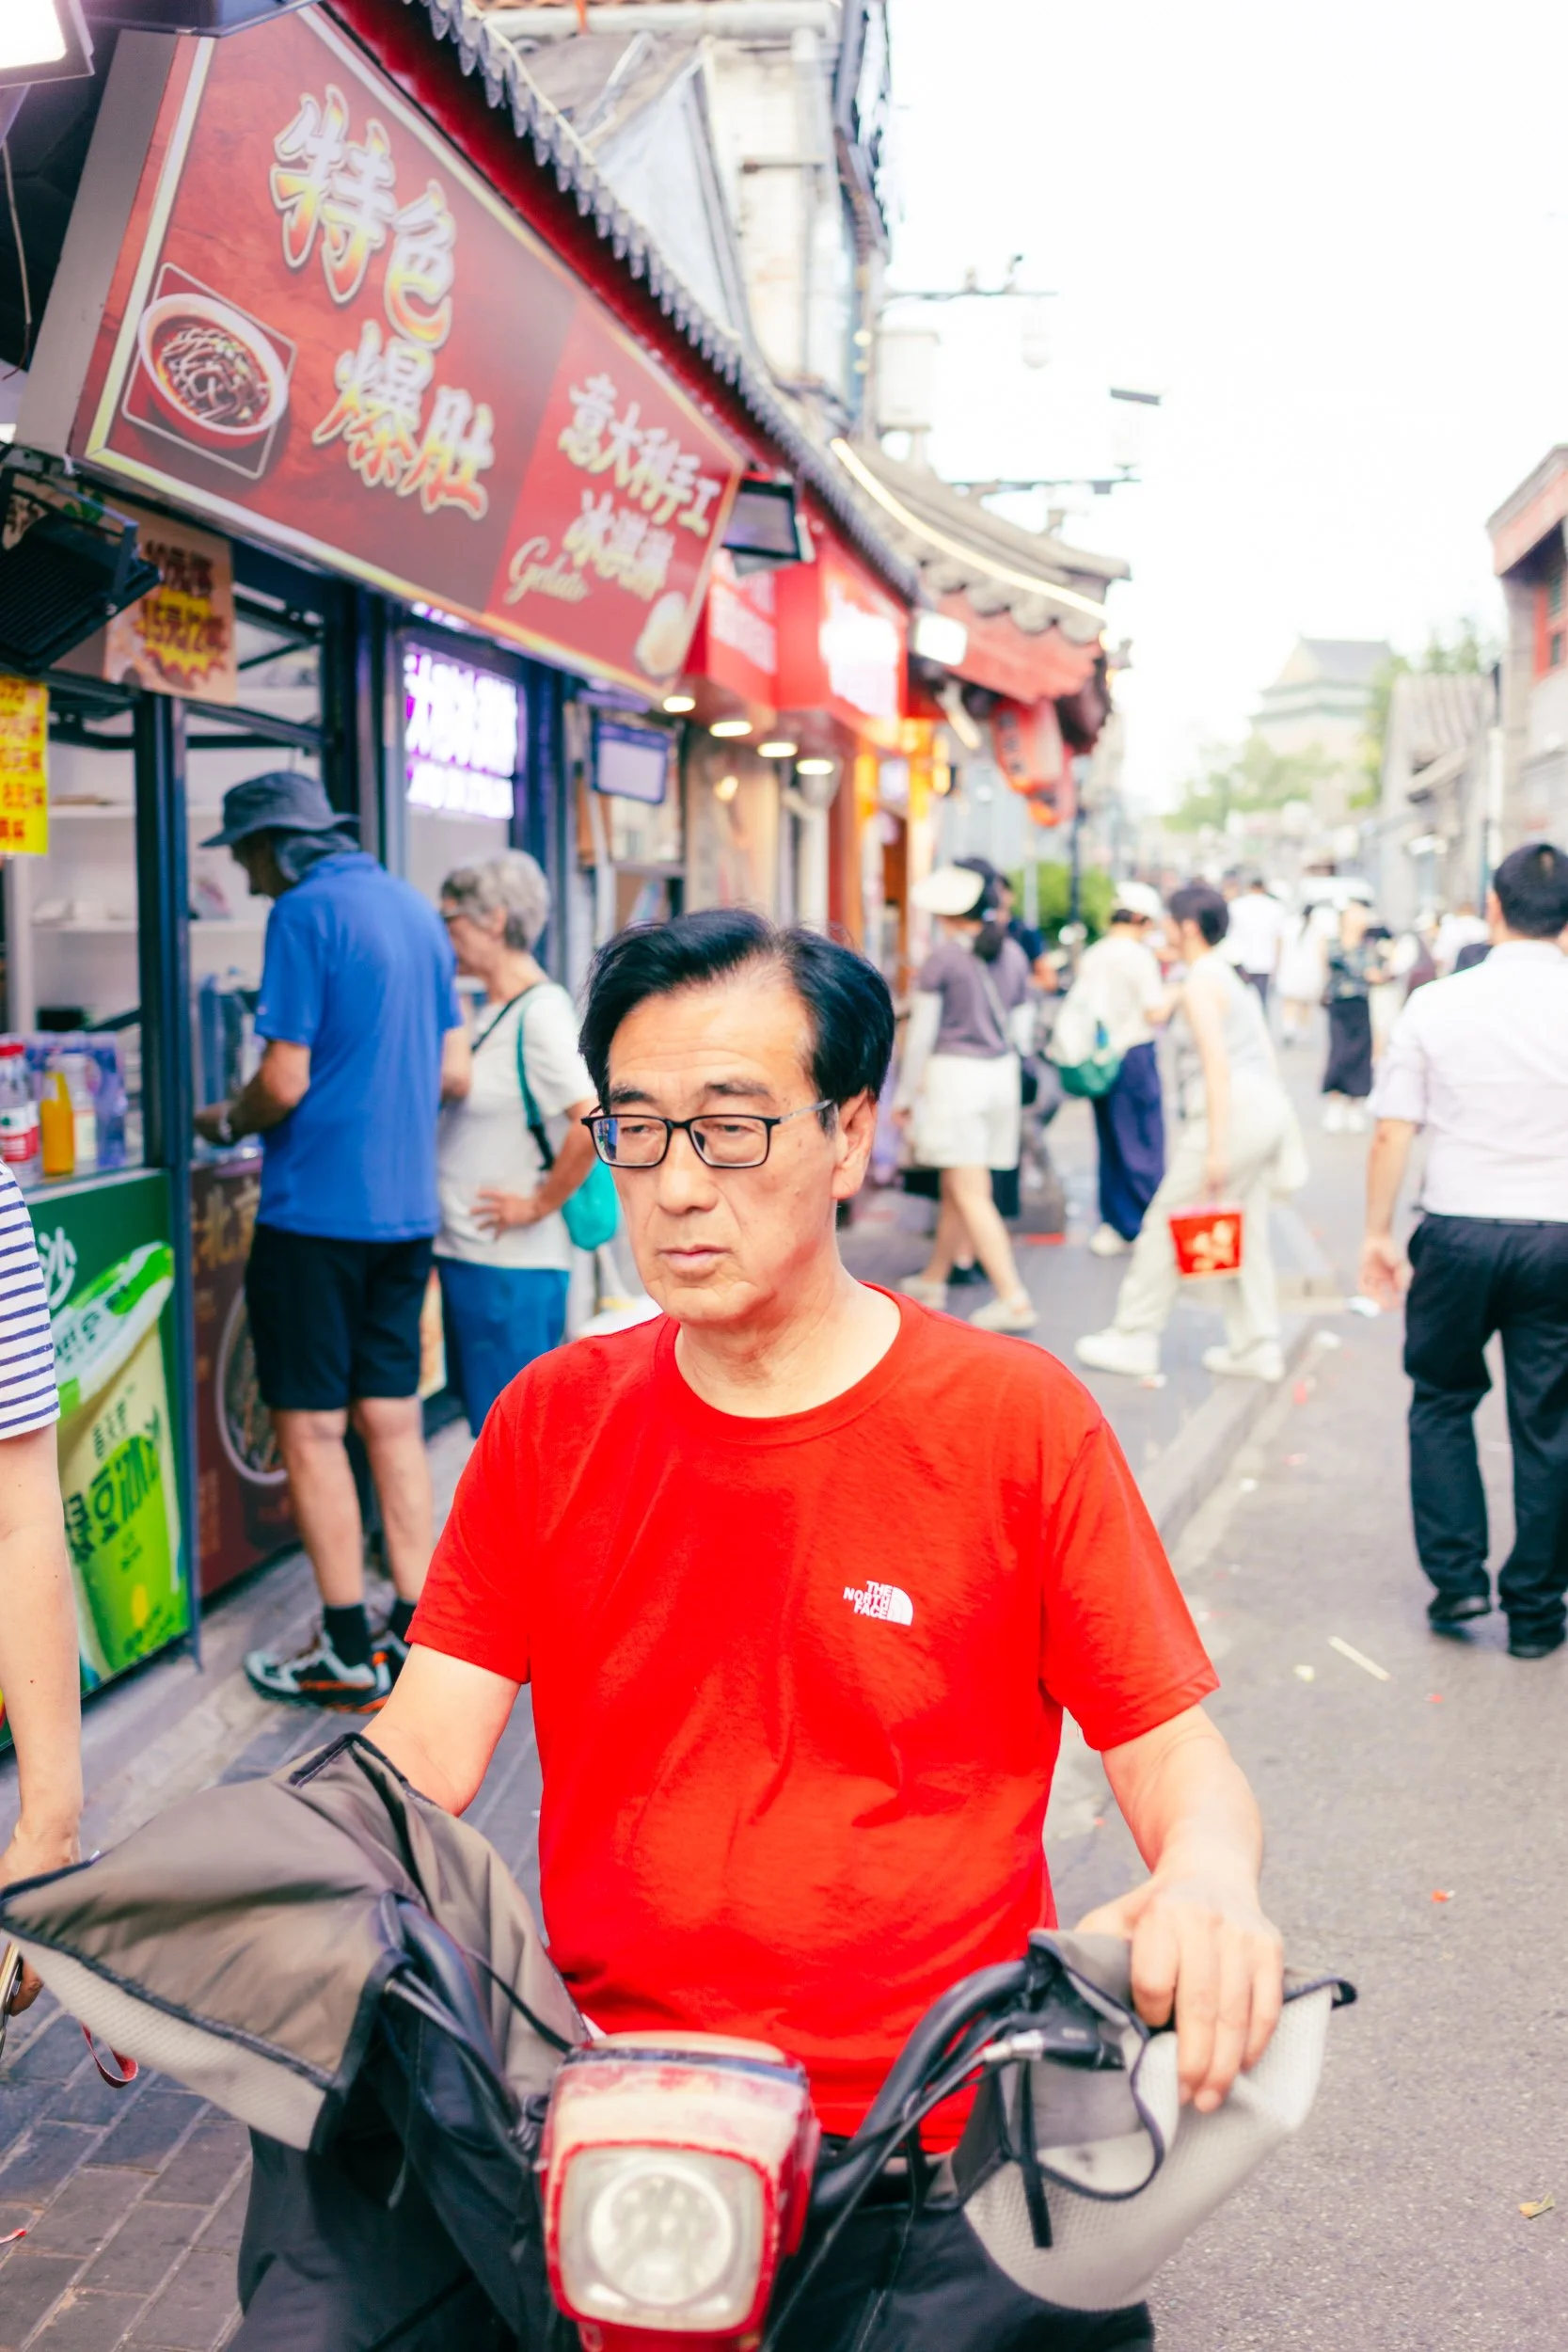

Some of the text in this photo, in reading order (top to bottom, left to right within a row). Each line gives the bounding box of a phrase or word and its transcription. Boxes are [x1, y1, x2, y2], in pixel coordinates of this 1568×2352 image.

[270, 84, 455, 350] 特色
[312, 319, 495, 519] 爆肚
[558, 373, 721, 538] 意大利手工
[843, 1586, 892, 1608] NORTH
[853, 1599, 889, 1620] FACE
[866, 1580, 894, 1597] THE
